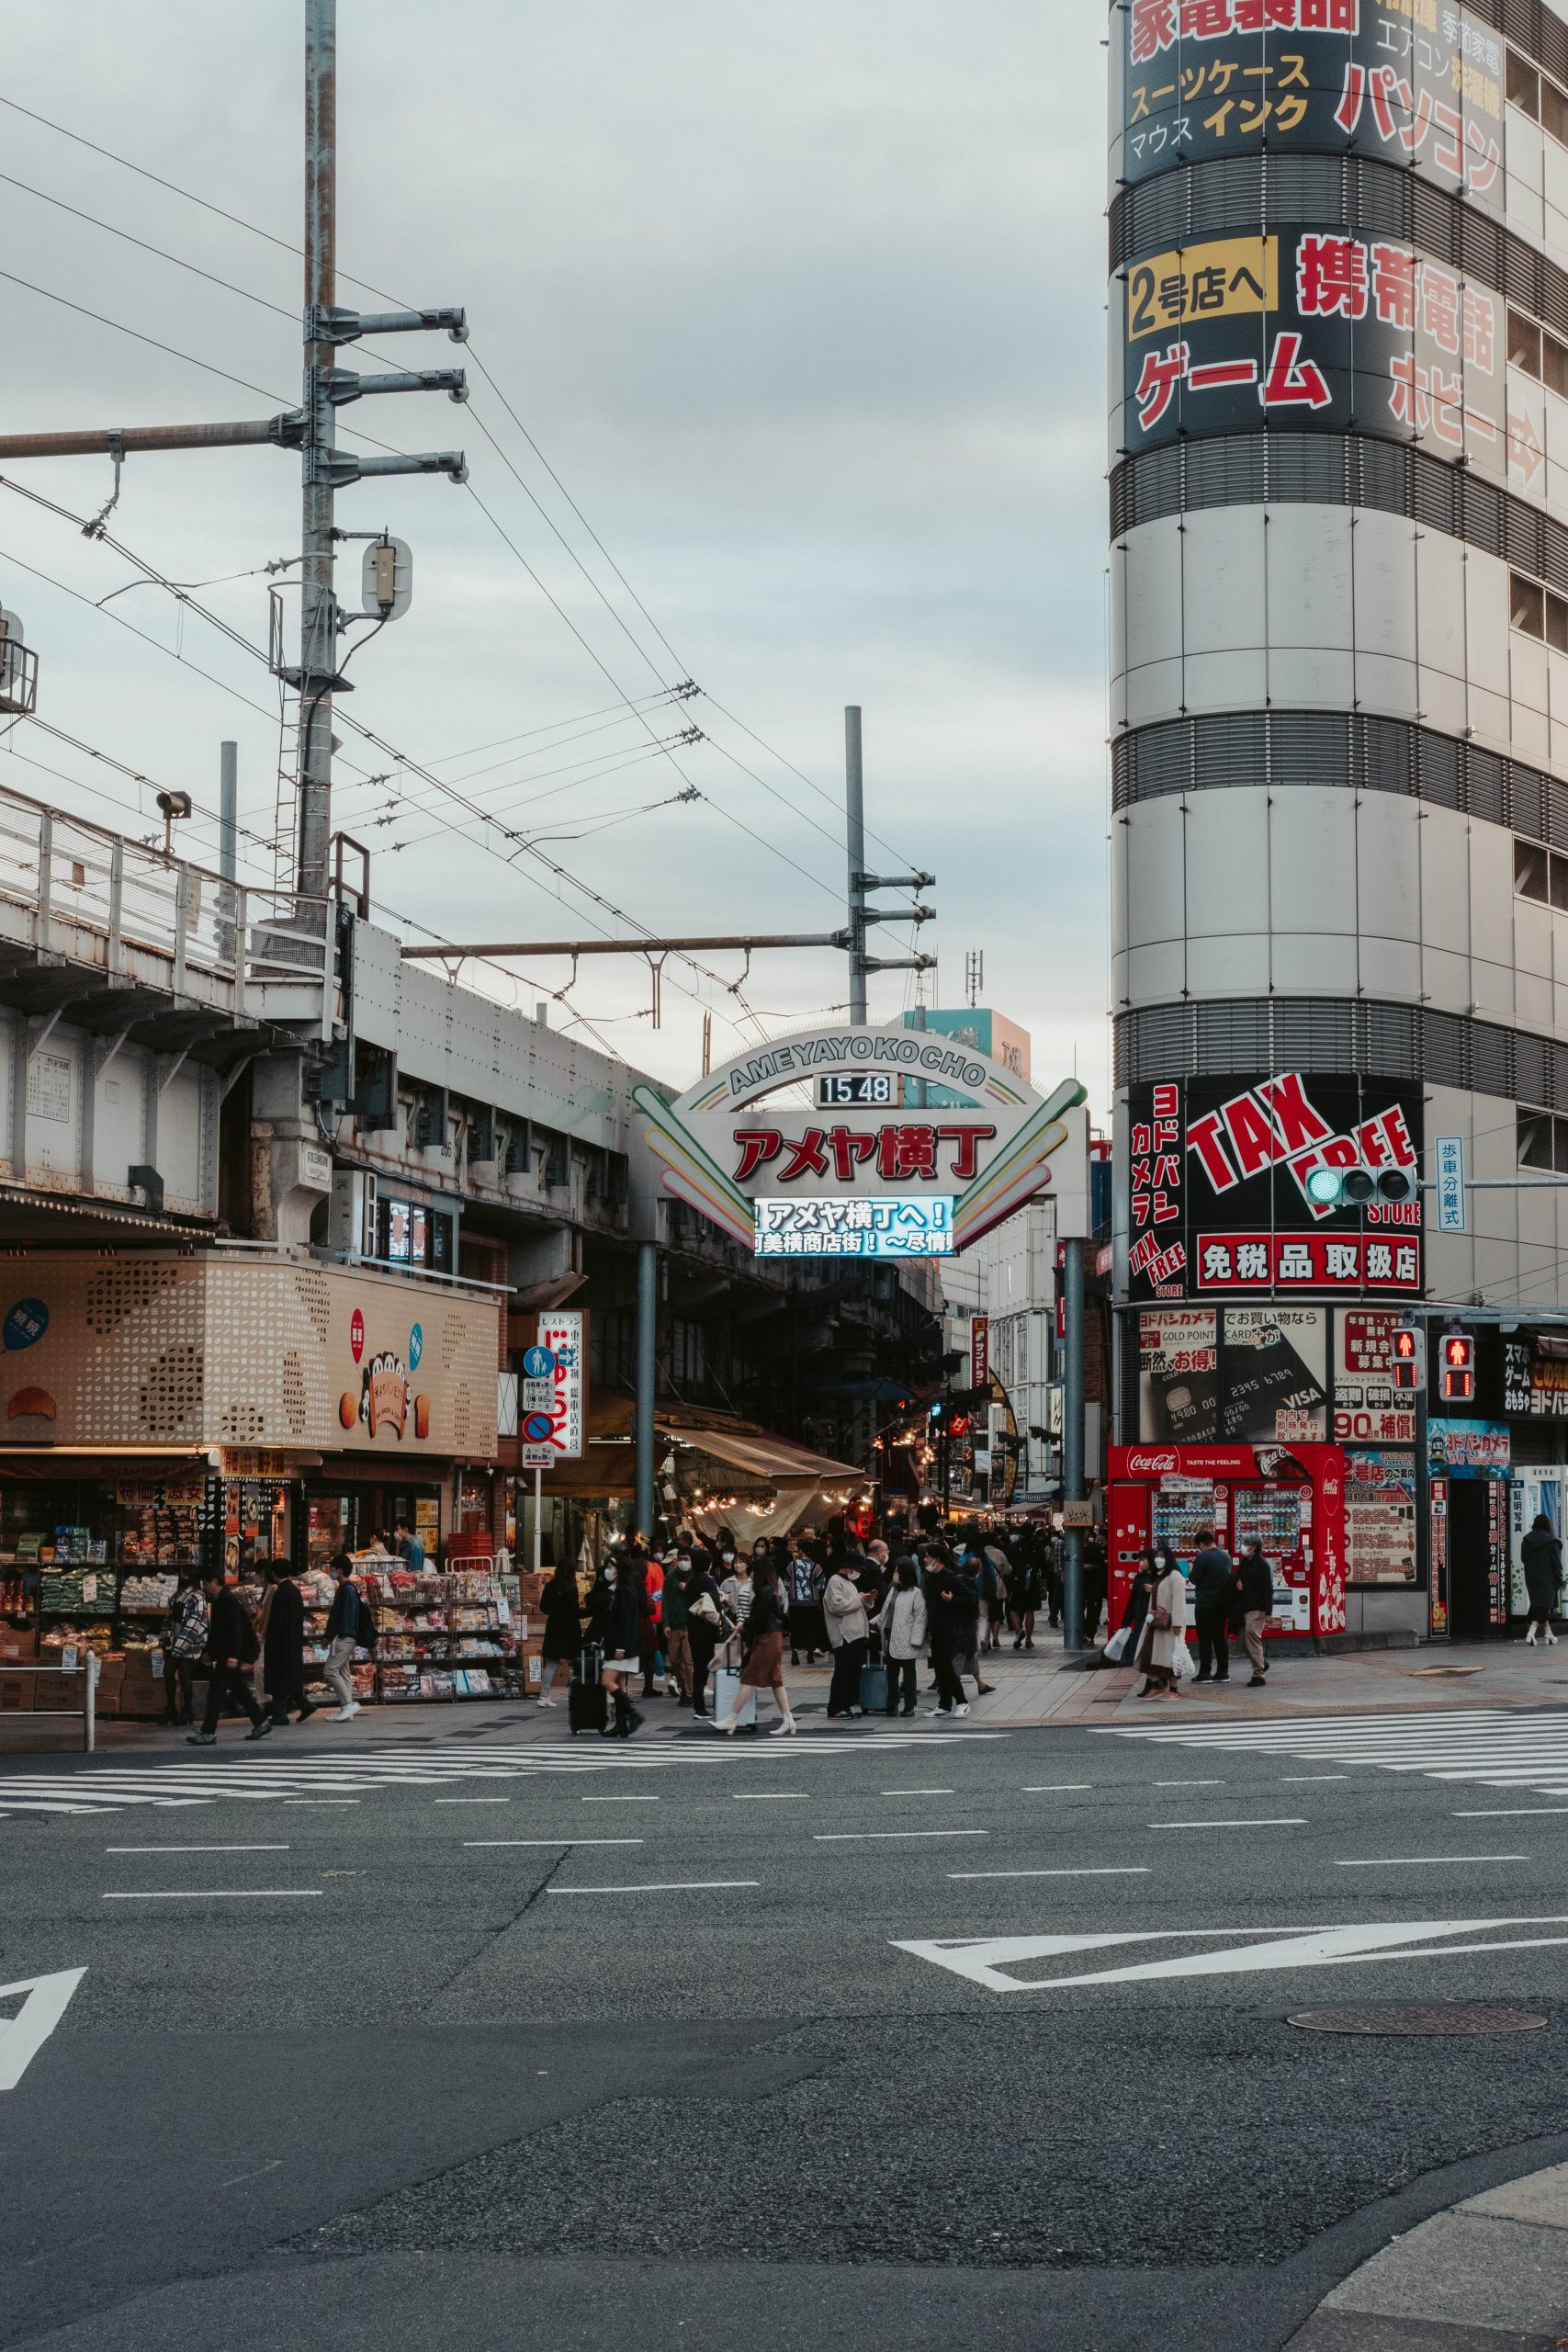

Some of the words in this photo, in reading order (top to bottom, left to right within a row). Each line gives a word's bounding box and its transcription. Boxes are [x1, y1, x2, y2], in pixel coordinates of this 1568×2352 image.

[1377, 18, 1450, 77] エアコン
[1131, 55, 1310, 124] スーツケース
[1202, 95, 1308, 137] インク
[1334, 62, 1499, 190] パソコン
[1131, 117, 1192, 158] マウス
[1132, 266, 1270, 334] 2号店へ
[1296, 233, 1495, 377] 携帯電話
[1135, 332, 1332, 431] ゲーム
[1388, 351, 1496, 447] ホビー
[728, 1035, 986, 1095] AMEYAYOKOCHO
[1186, 1072, 1334, 1194] TAX
[732, 1125, 998, 1182] アメヤ横丁
[1153, 1084, 1179, 1224] ヨドバシ
[1131, 1124, 1151, 1226] カメラ
[1441, 1143, 1460, 1226] 歩車分離式
[1367, 1200, 1421, 1226] STORE
[1128, 1230, 1161, 1276] TAX
[1146, 1241, 1187, 1287] FREE
[1203, 1243, 1416, 1281] 免税品取扱店
[1156, 1284, 1183, 1297] STORE
[542, 1317, 581, 1326] レストラン
[1140, 1312, 1215, 1328] ヨドバシカメラ
[1224, 1311, 1317, 1326] でお買い物なら
[1366, 1326, 1386, 1337] 無料
[1162, 1331, 1185, 1341] GOLD
[1187, 1331, 1215, 1340] POINT
[1224, 1329, 1252, 1340] CARD
[1505, 1343, 1530, 1364] スマホ
[1231, 1379, 1259, 1396] 2345
[1264, 1368, 1293, 1385] 6789
[1505, 1365, 1530, 1387] ゲーム
[1201, 1396, 1217, 1410] 00
[1280, 1387, 1322, 1408] VISA
[1334, 1388, 1362, 1401] 盗難
[1367, 1388, 1391, 1401] 破損
[1505, 1389, 1530, 1411] おもちゃ
[1277, 1410, 1307, 1419] 店内で
[1277, 1420, 1318, 1430] 即時発行
[1130, 1453, 1177, 1471] Coca-Cola
